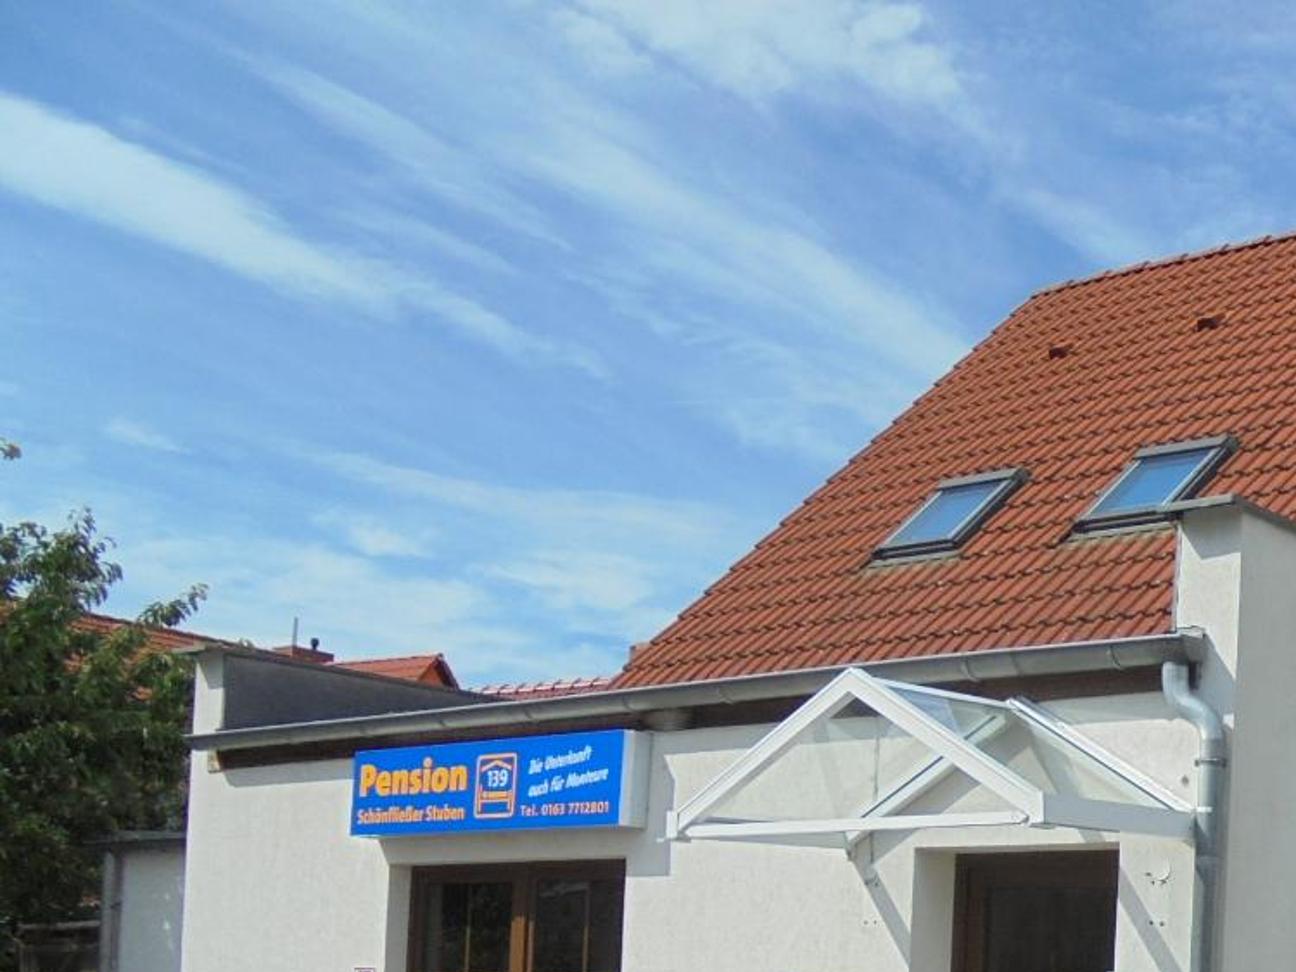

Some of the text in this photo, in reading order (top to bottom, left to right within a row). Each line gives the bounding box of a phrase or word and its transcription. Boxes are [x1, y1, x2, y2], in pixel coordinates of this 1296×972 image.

[544, 745, 592, 770] Unterkunft
[359, 757, 468, 796] Pension
[487, 769, 508, 788] 139
[528, 779, 549, 797] auch
[565, 768, 609, 788] Monteure
[425, 804, 465, 821] Stuben
[520, 801, 609, 817] Tel. 0163 7712801
